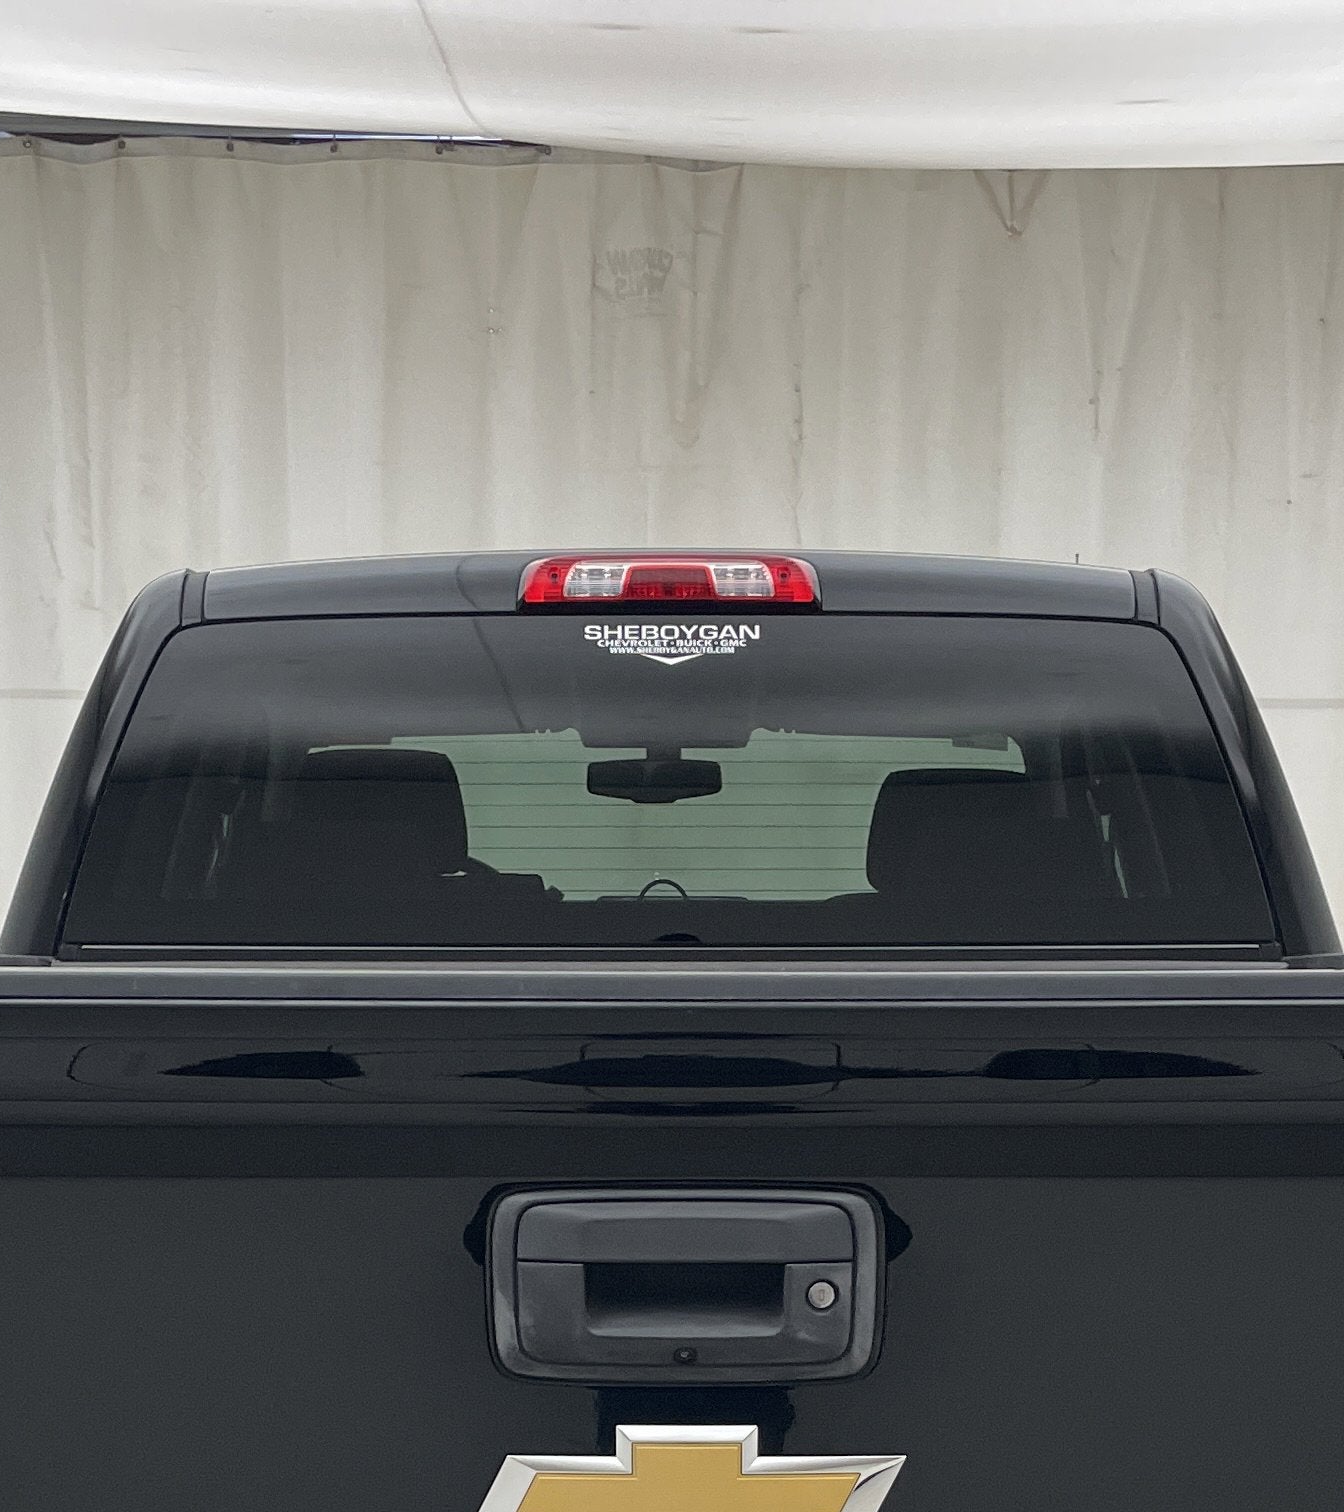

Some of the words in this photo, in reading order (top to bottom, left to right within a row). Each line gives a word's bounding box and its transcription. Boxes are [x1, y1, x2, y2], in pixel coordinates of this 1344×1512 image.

[584, 624, 761, 640] SHEBOYGAN
[596, 639, 668, 647] CHEVROLET
[675, 639, 713, 647] BUICK
[719, 639, 747, 647] GMC
